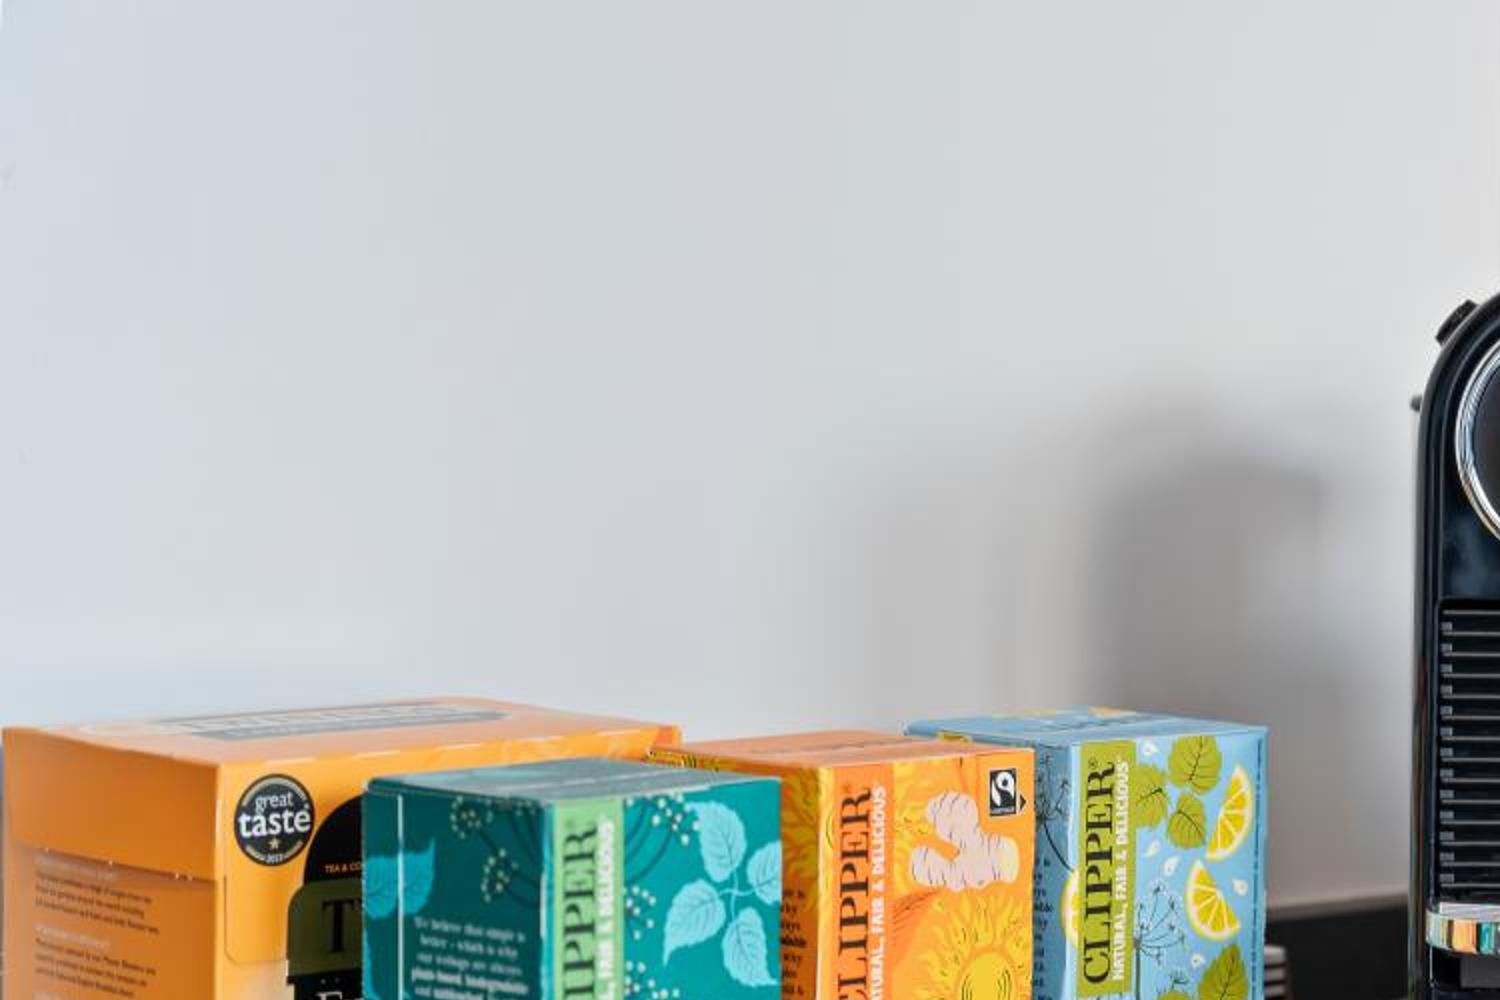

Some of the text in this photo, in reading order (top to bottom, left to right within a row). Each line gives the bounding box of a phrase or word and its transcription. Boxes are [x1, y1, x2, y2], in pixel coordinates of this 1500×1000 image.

[238, 806, 311, 838] taste
[255, 791, 293, 814] great
[871, 786, 886, 876] DELICIOUS
[1115, 760, 1129, 845] DELICIOUS
[1083, 761, 1115, 984] CLIPPER
[1114, 865, 1128, 900] FAIR
[871, 897, 885, 934] FAIR
[1111, 902, 1128, 981] NATURAL,
